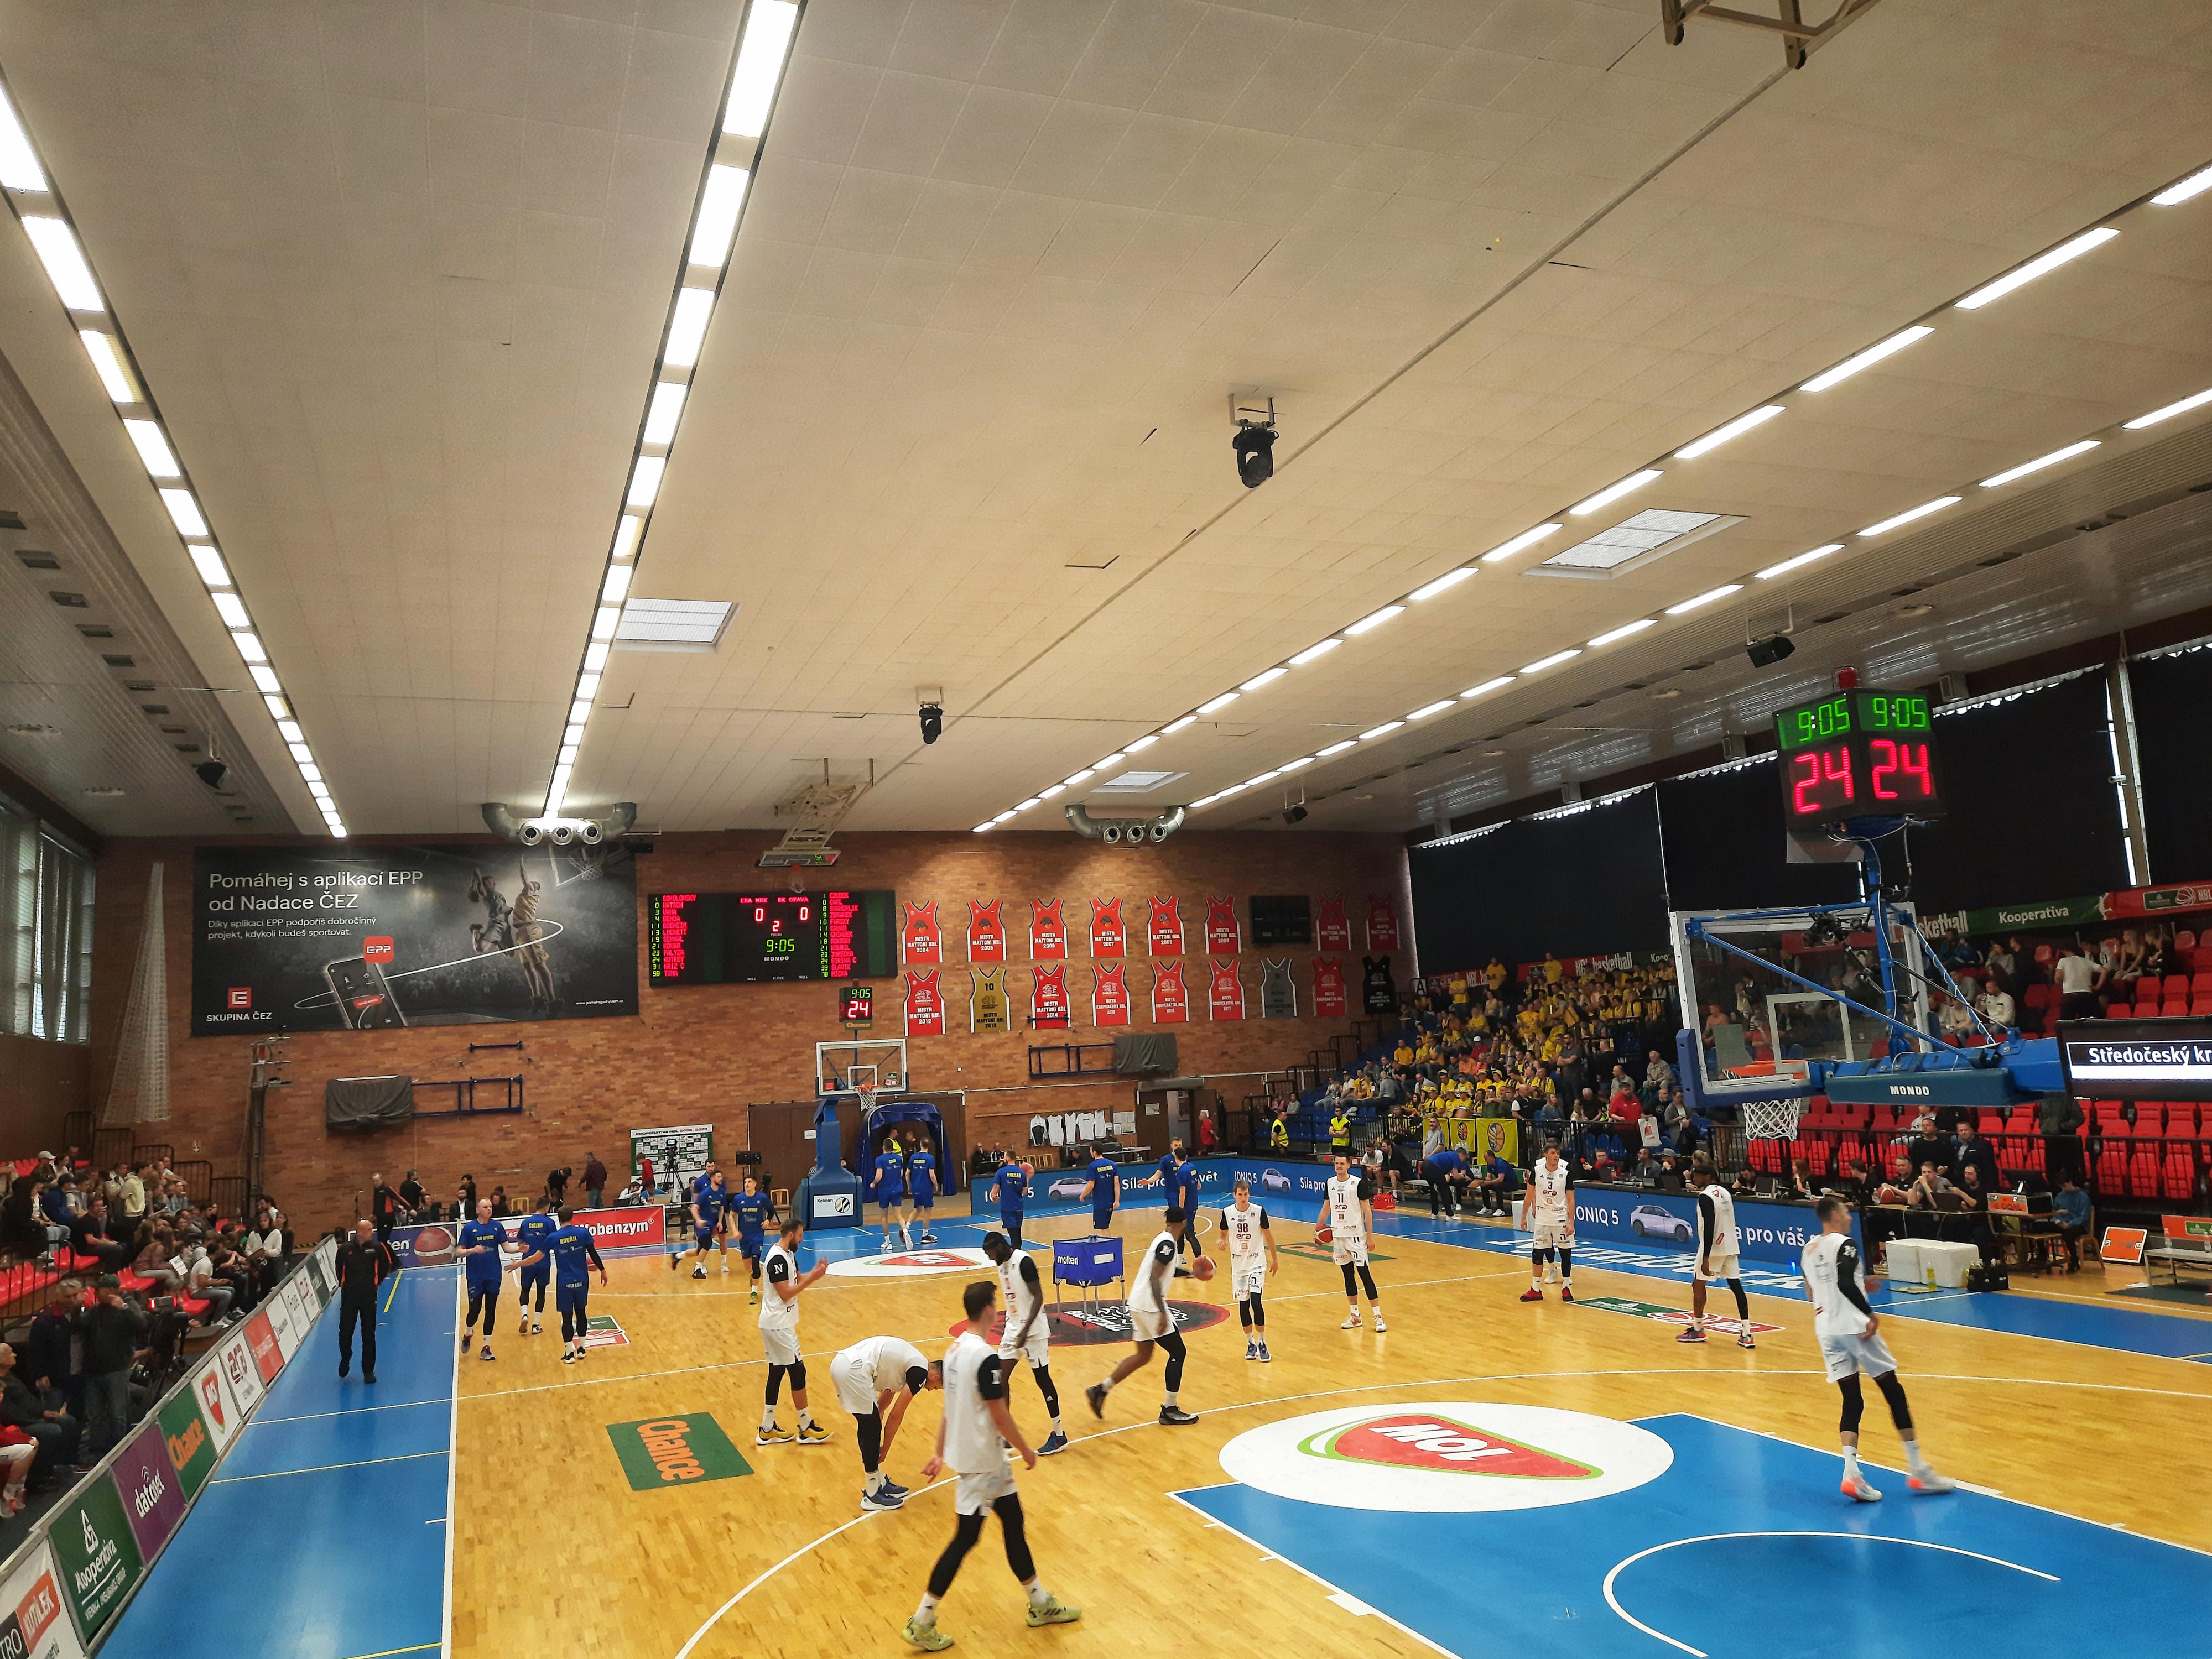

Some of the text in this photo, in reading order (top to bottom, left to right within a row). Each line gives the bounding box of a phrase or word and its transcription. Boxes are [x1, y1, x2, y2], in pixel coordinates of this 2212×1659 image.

[1874, 698, 1926, 727] 9:05
[1798, 698, 1850, 742] 9:05
[1871, 739, 1931, 799] 24
[1794, 747, 1854, 813] 24
[210, 871, 423, 890] Pomáhej s aplikací EPP
[209, 891, 358, 911] od Nadace ČEZ
[756, 908, 763, 921] 0
[800, 907, 808, 920] 0
[209, 920, 227, 929] Díky
[230, 920, 264, 928] aplikaci
[286, 918, 325, 927] podpoříš
[327, 917, 376, 925] dobročinný
[772, 920, 779, 932] 2
[1918, 906, 2069, 940] sketball Kooperativa
[246, 930, 276, 939] kdykoli
[279, 929, 305, 937] budeš
[367, 946, 391, 954] EPP
[767, 938, 795, 952] 9:05
[851, 989, 871, 998] 9:05
[985, 983, 994, 991] 10
[847, 1000, 868, 1018] 24
[206, 1011, 272, 1022] SKUPINA ČEZ
[2089, 1045, 2212, 1066] Středočeský kr
[1890, 1086, 1930, 1095] MONDO
[1196, 1171, 1219, 1183] vět
[1235, 1171, 1257, 1185] IONIQ 5
[1300, 1177, 1326, 1193] Síla pro
[1548, 1181, 1553, 1190] 3
[1027, 1187, 1034, 1198] 5
[1337, 1193, 1344, 1203] 11
[1574, 1206, 1619, 1227] ONIQ 5
[1237, 1223, 1248, 1233] 98
[1746, 1227, 1773, 1245] pro
[1777, 1227, 1805, 1246] váš
[1057, 1255, 1079, 1265] molten
[168, 1417, 205, 1470] Chance
[1369, 1423, 1514, 1462] MOL
[636, 1419, 706, 1482] Chance
[74, 1538, 118, 1594] Kooperativa
